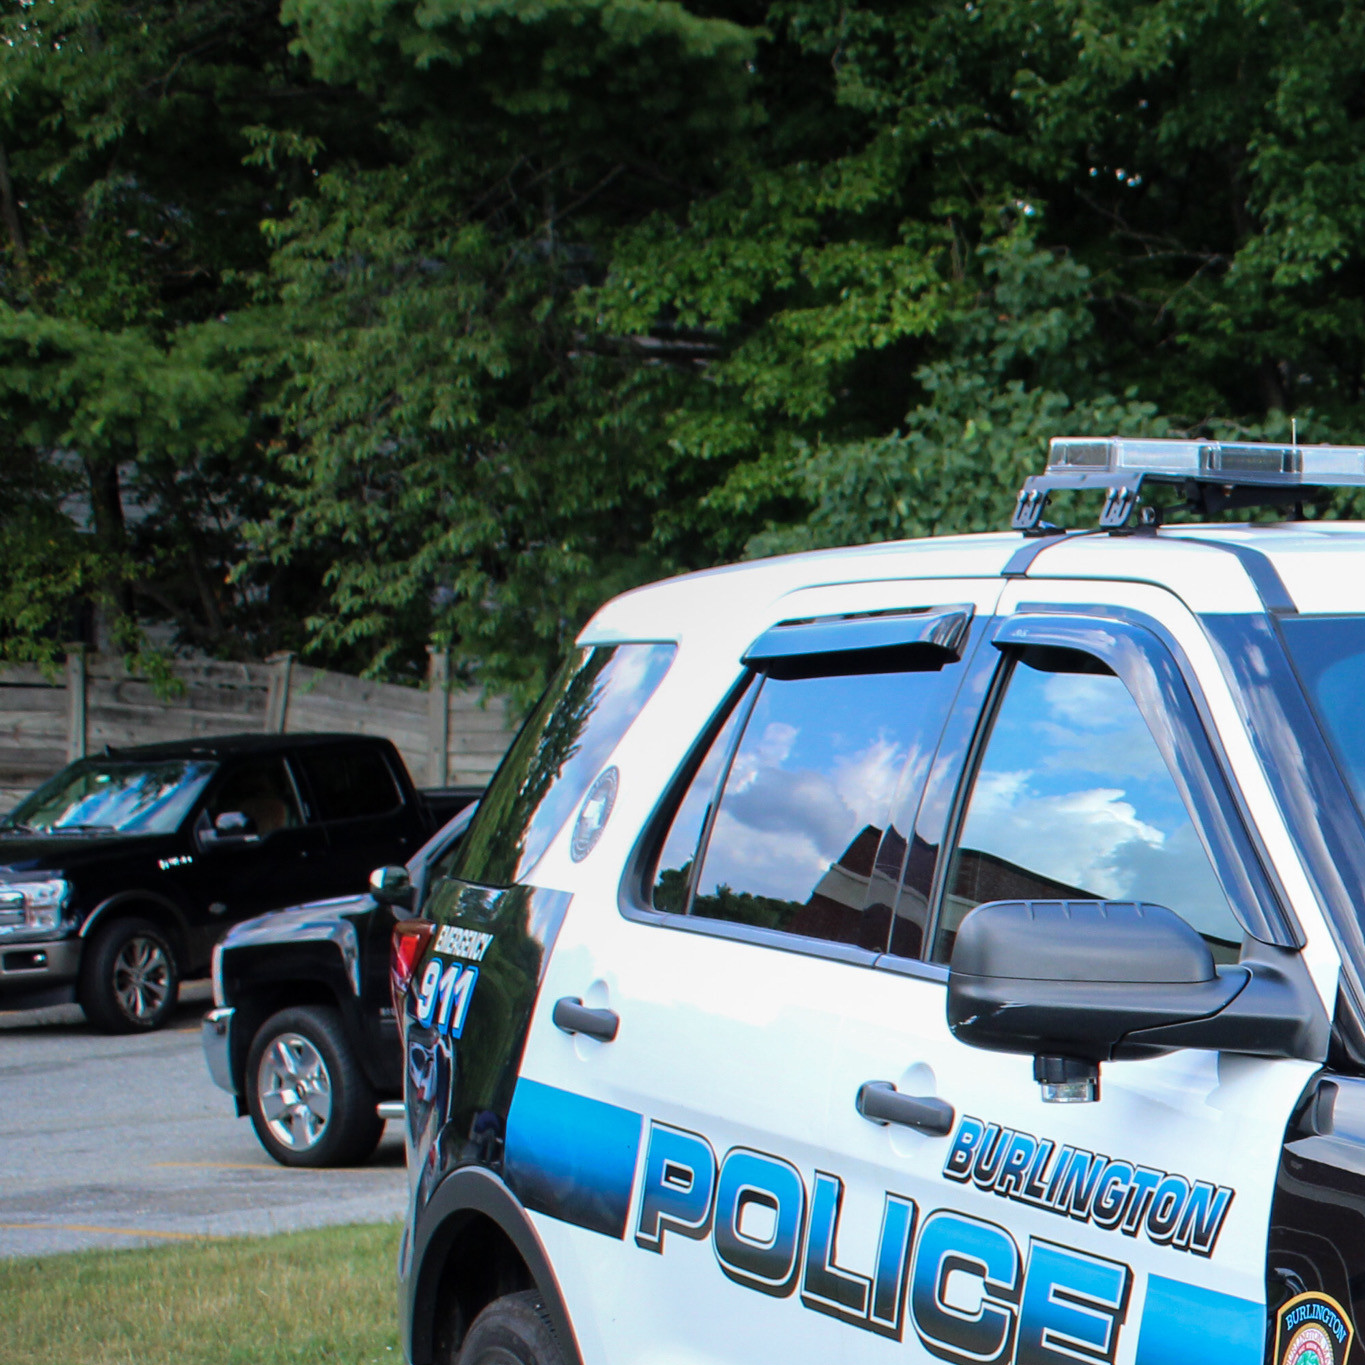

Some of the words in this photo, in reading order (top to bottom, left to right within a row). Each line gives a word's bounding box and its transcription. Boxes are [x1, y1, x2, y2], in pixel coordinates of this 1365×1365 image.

[433, 924, 494, 962] EMERGENCY
[416, 957, 479, 1040] 911
[942, 1114, 1236, 1259] BURLINGTON
[1285, 1303, 1348, 1344] BURLINGTON
